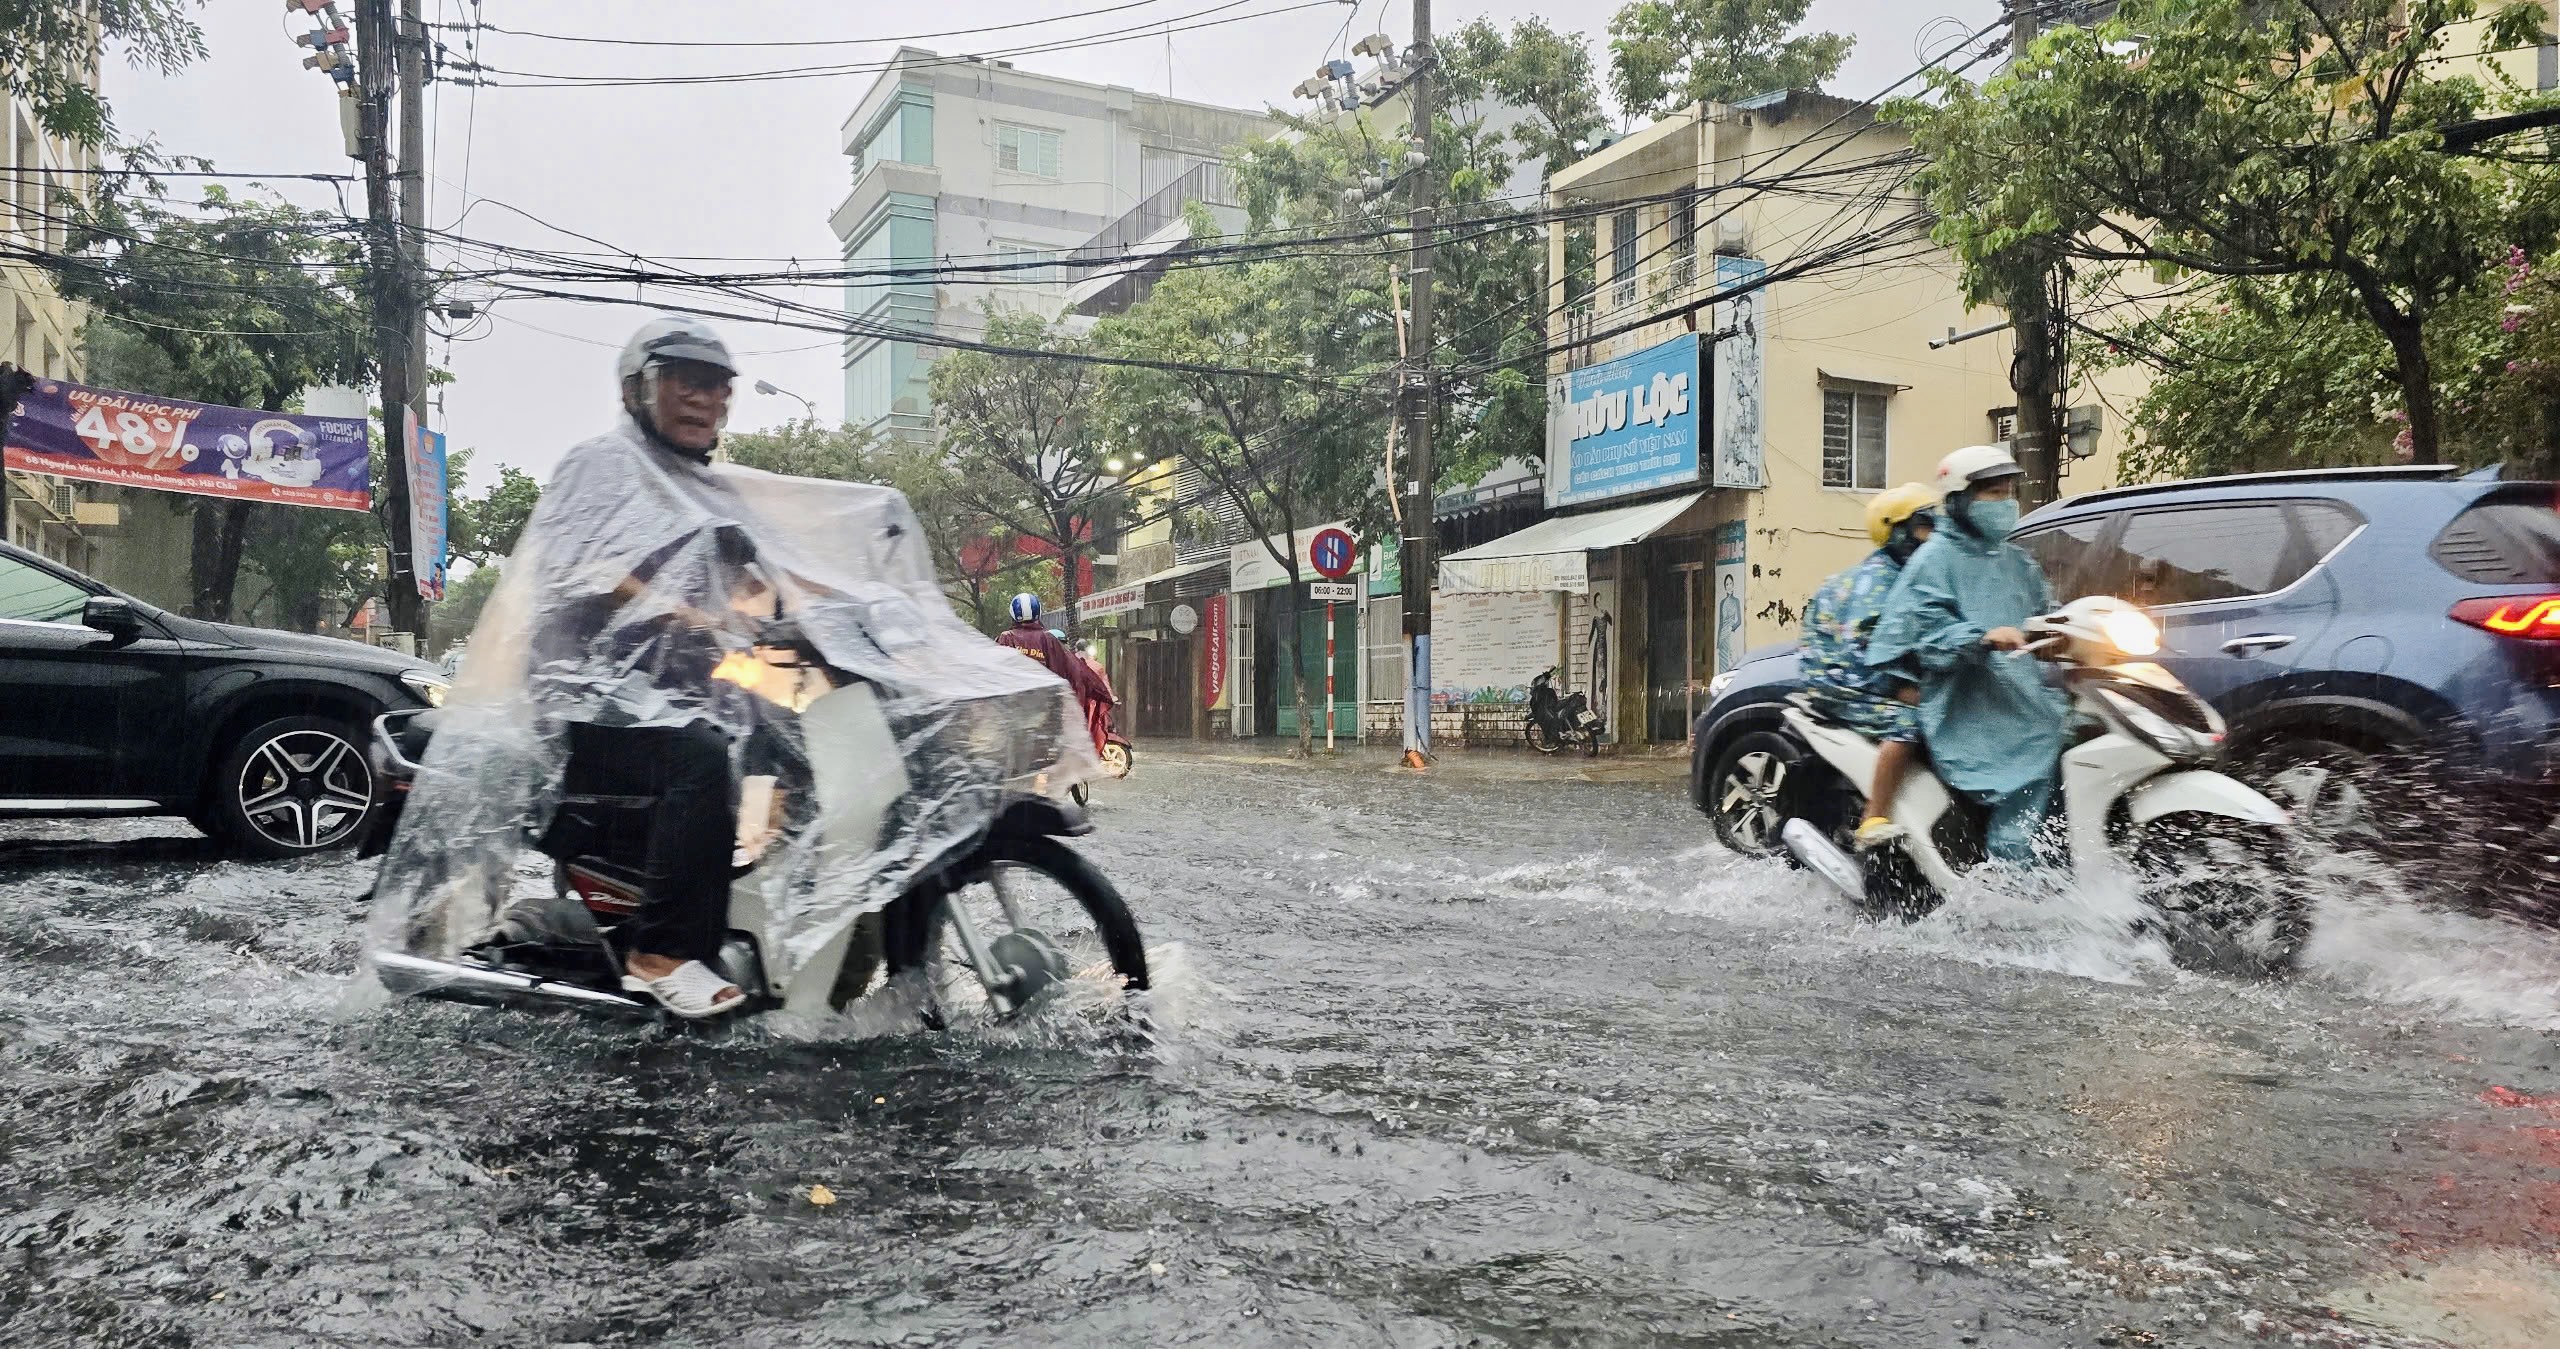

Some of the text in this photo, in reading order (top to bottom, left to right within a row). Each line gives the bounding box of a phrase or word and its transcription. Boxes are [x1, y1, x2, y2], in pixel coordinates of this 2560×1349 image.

[68, 390, 203, 420] ƯU ĐÃI HỌC PHÍ
[1571, 372, 1688, 440] HỮU LỘC
[75, 406, 200, 462] 48%
[319, 421, 354, 437] FOCUS
[1584, 446, 1602, 466] DÀI
[1603, 444, 1622, 463] PHỤ
[1639, 432, 1662, 455] VIỆT
[1663, 429, 1688, 449] NAM
[1616, 462, 1639, 476] THEO
[1336, 587, 1353, 596] 22:00
